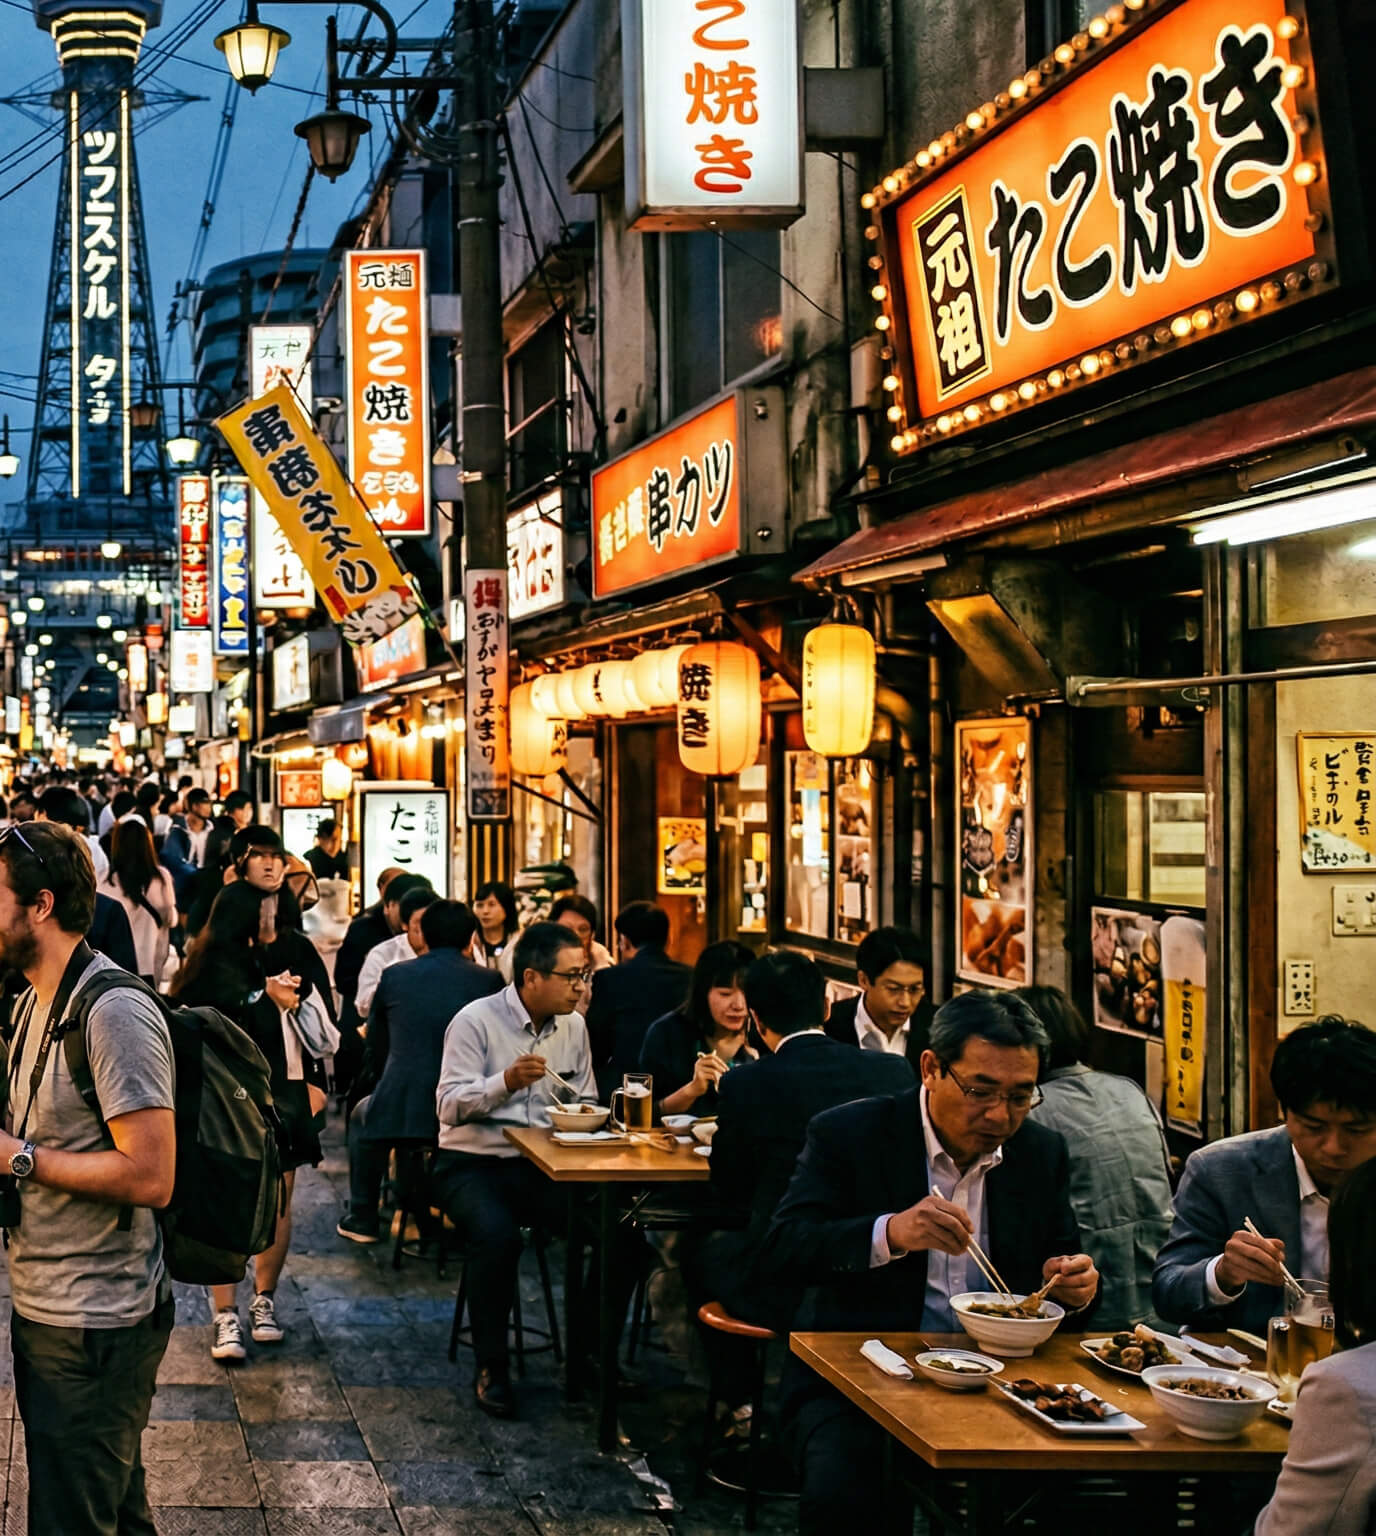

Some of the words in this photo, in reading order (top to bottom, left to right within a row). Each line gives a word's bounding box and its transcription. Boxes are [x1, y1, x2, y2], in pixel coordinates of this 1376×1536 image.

[988, 32, 1291, 341] たこ焼き
[926, 213, 982, 377] 元祖
[364, 296, 411, 466] たこ焼き
[647, 442, 730, 549] 串カツ
